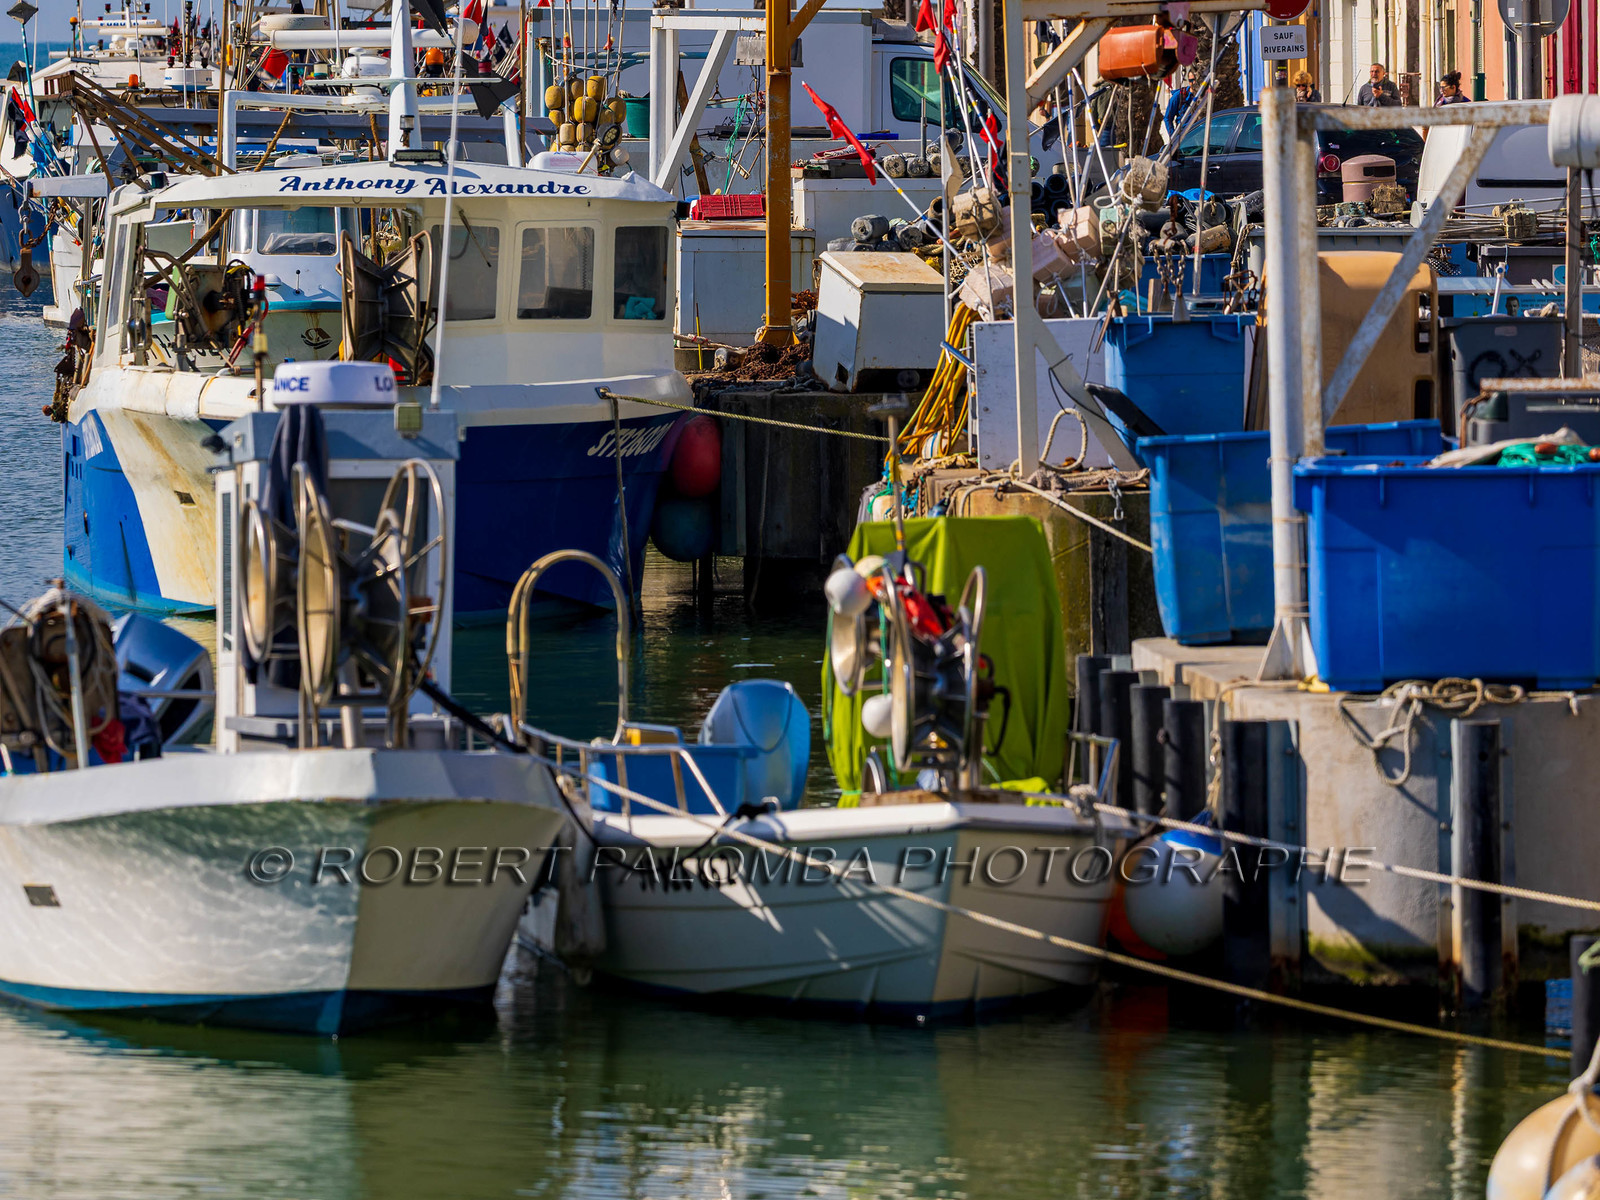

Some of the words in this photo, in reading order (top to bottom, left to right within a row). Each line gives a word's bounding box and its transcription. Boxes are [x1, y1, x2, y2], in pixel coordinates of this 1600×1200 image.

[1273, 32, 1294, 40] SAUF
[1263, 44, 1305, 54] RIVERAINS
[279, 175, 418, 194] Anthony
[424, 177, 591, 196] Alexandre
